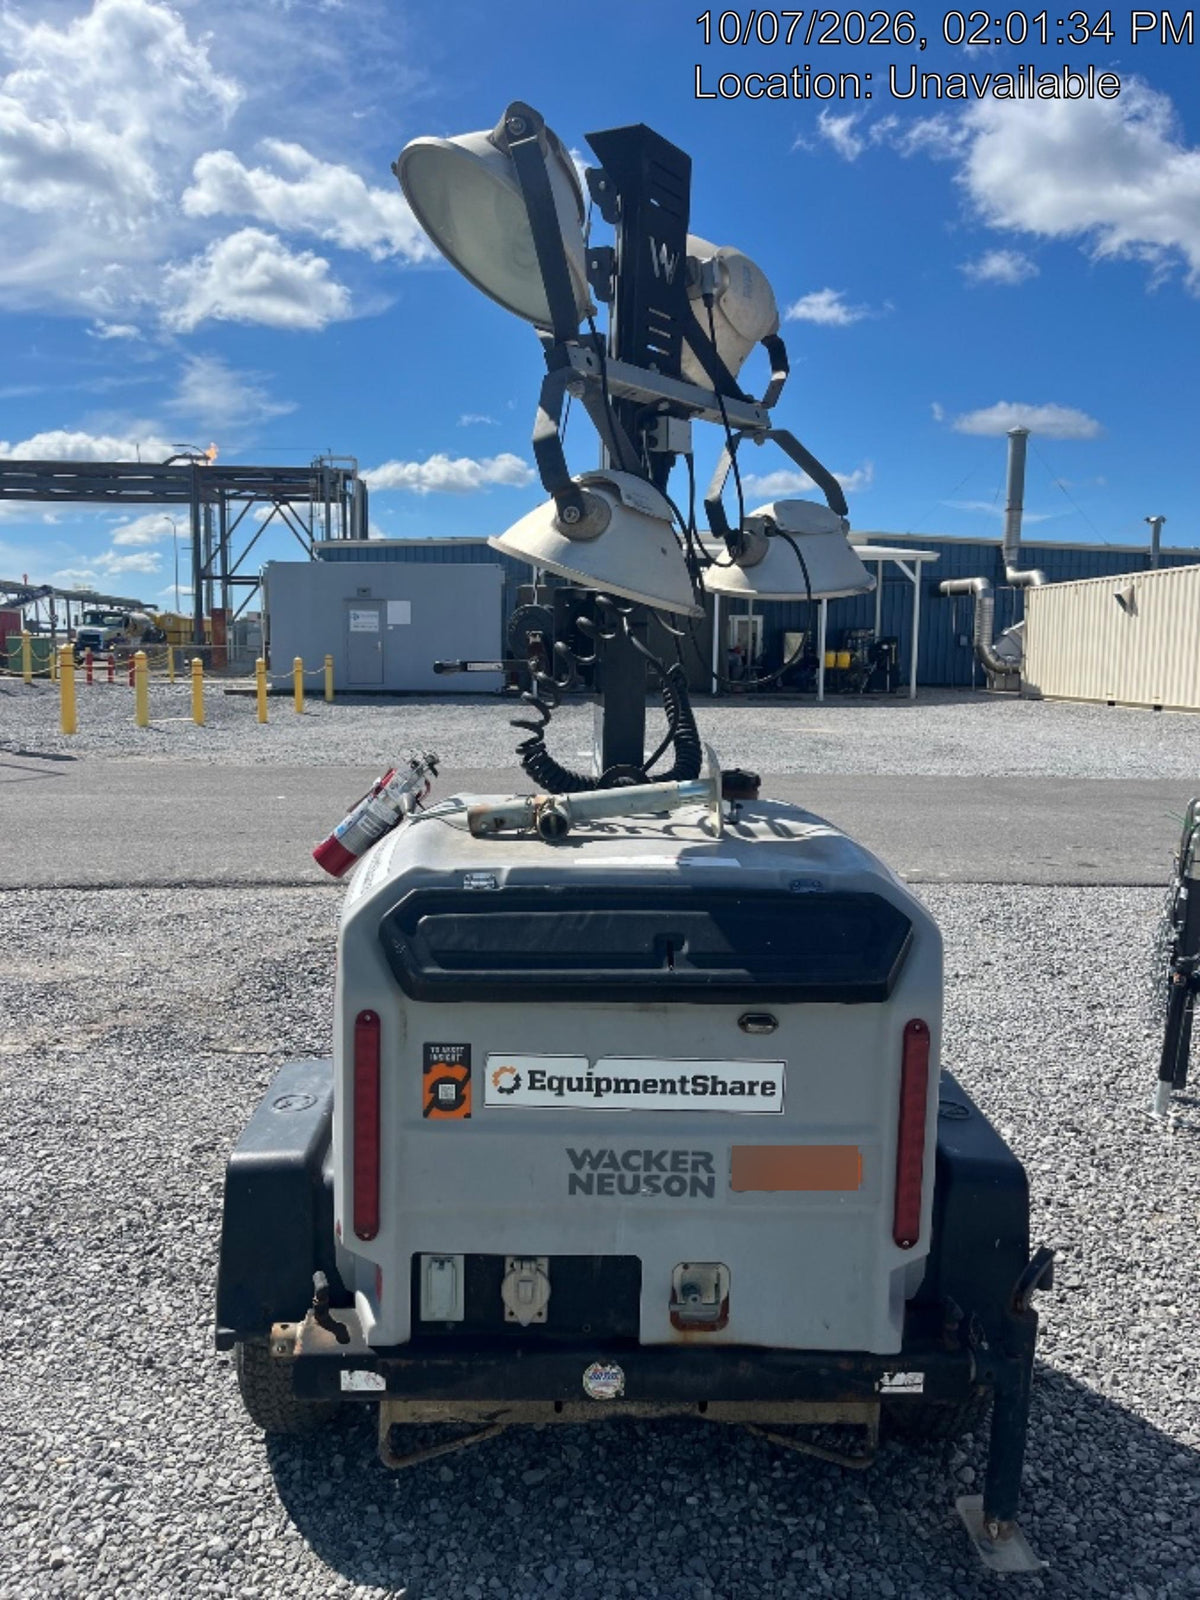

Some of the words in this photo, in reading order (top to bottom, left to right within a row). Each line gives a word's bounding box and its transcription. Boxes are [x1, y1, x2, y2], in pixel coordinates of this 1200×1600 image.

[527, 1069, 776, 1097] EquipmentShare
[565, 1148, 715, 1173] WACKER
[568, 1173, 715, 1198] NEUSON
